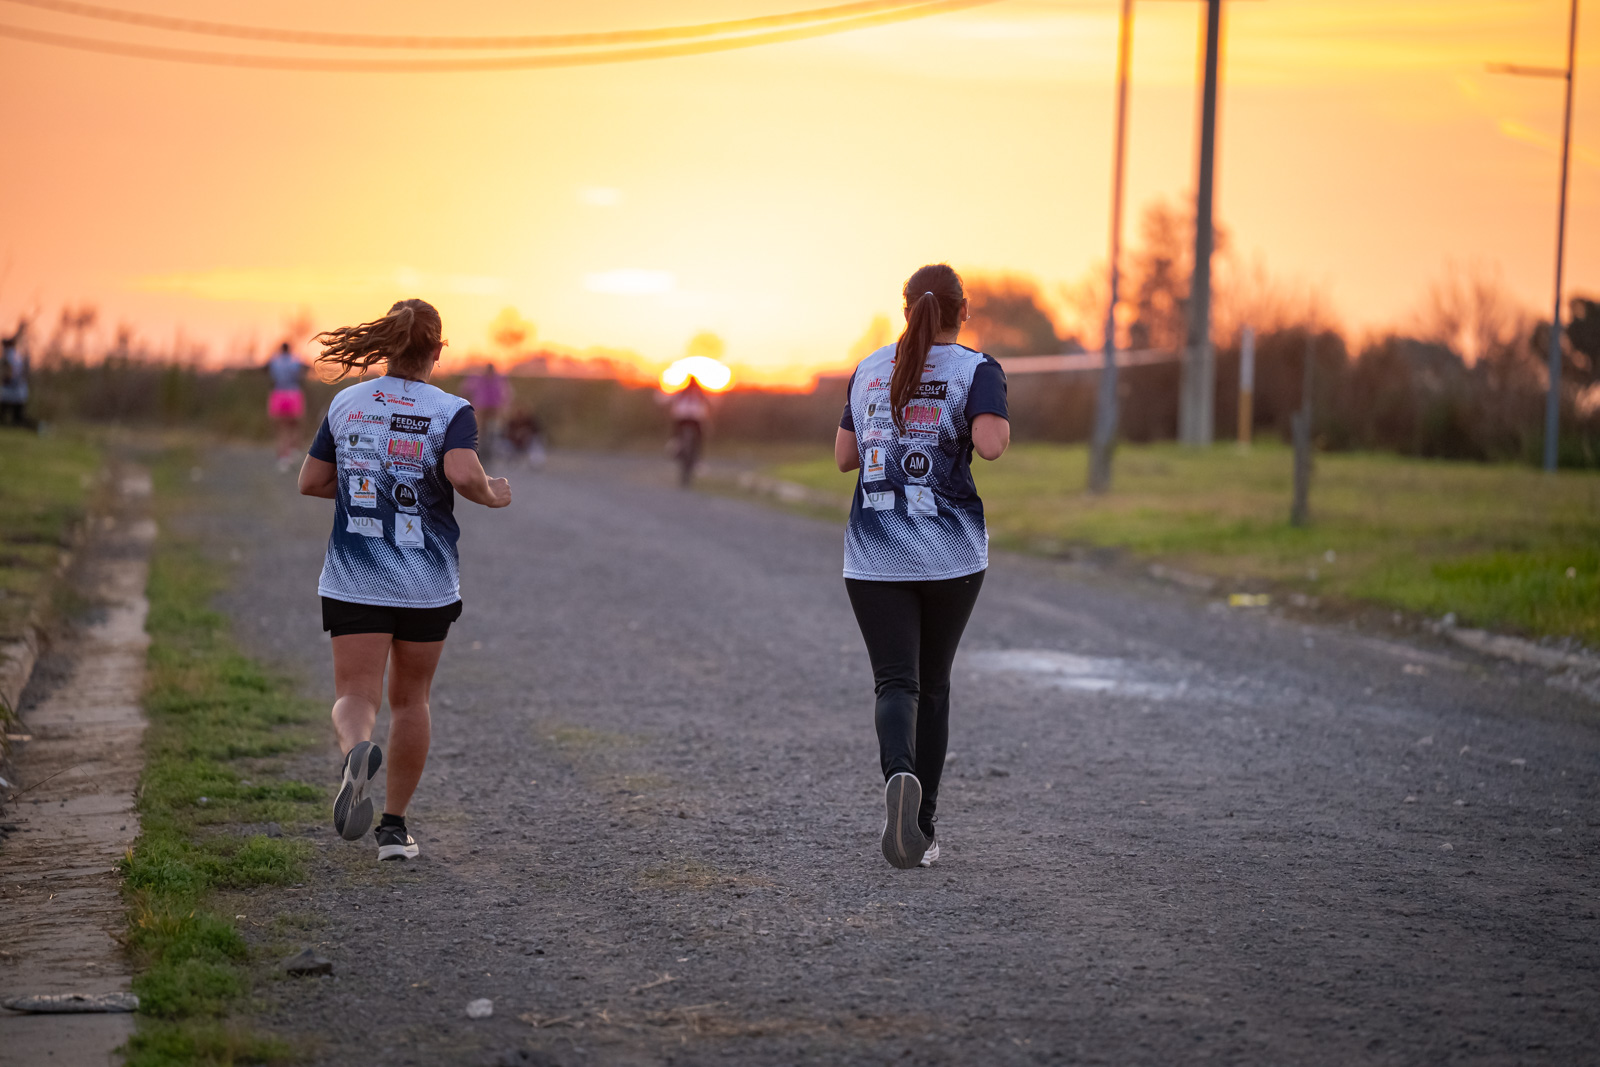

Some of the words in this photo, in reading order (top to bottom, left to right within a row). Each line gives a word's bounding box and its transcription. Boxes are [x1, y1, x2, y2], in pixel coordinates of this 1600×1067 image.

[391, 416, 429, 427] FEEDLOT
[910, 456, 925, 469] AM
[353, 518, 374, 527] NUT
